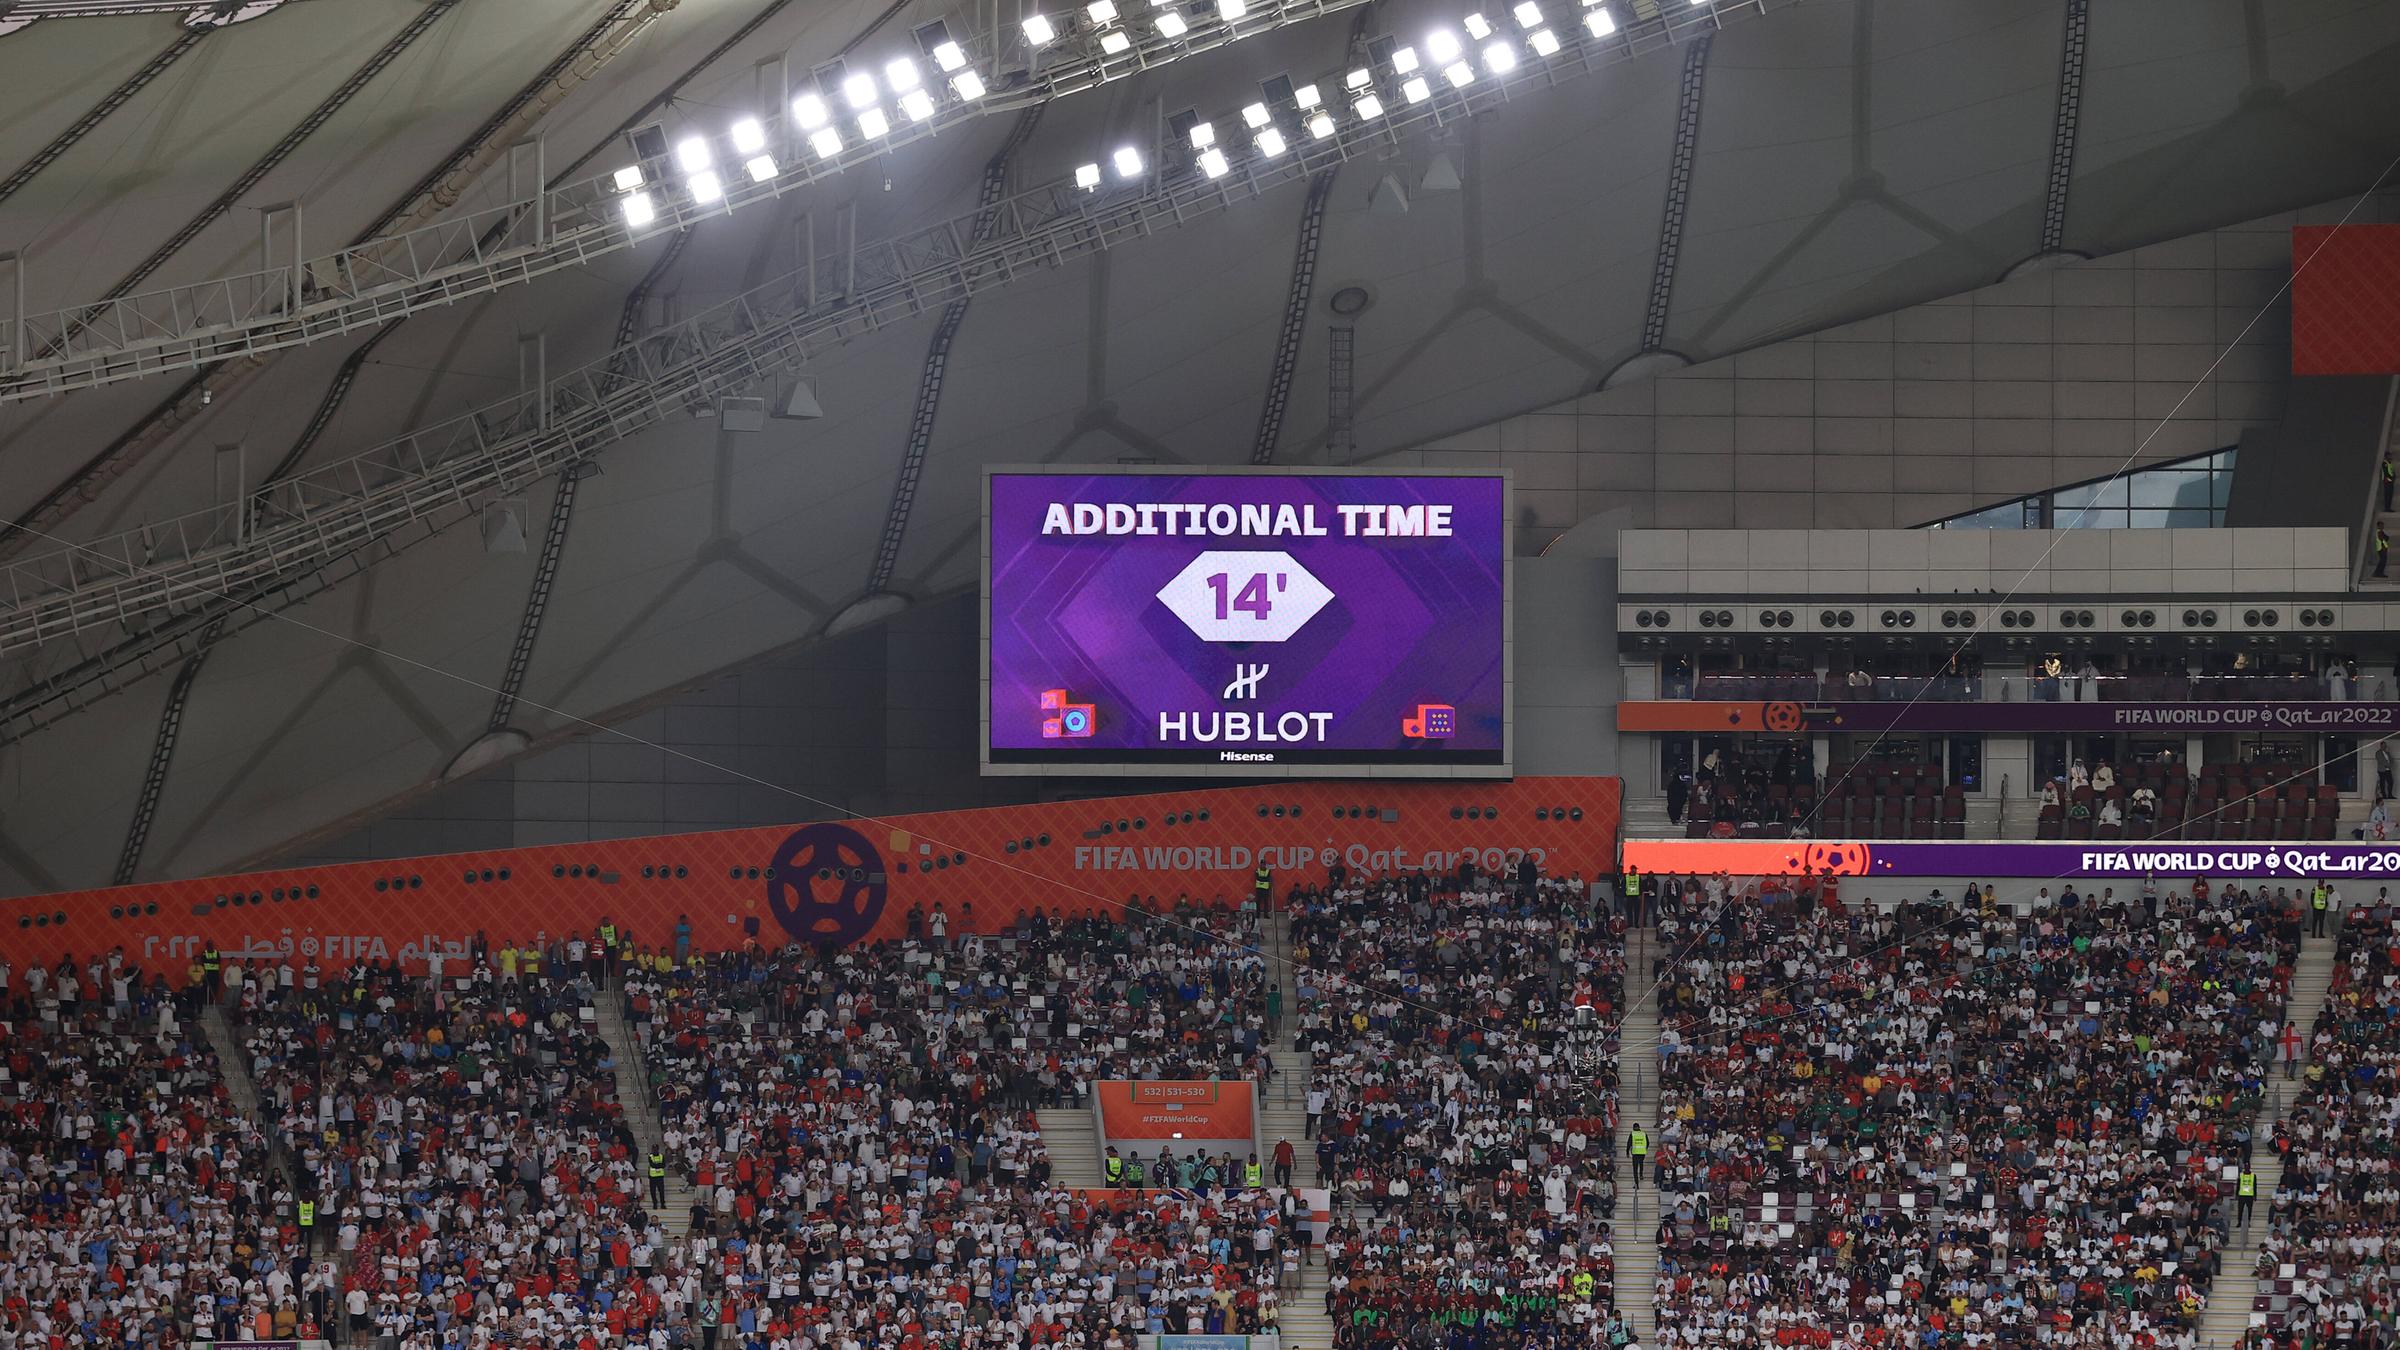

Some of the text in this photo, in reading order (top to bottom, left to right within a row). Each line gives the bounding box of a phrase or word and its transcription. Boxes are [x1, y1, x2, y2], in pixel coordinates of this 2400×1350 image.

[1041, 503, 1453, 537] ADDITIONAL TIME
[1207, 573, 1287, 620] 14'
[1159, 711, 1333, 742] HUBLOT
[2115, 709, 2156, 724] FIFA
[2155, 709, 2220, 724] WORLD
[2223, 709, 2258, 724] CUP
[1219, 752, 1275, 762] Hisense
[1074, 846, 1140, 870] FIFA
[1143, 846, 1251, 870] WORLD
[1257, 846, 1315, 870] CUP
[2082, 852, 2134, 871] FIFA
[2132, 852, 2214, 871] WORLD
[2217, 852, 2262, 871] CUP
[324, 936, 389, 960] FIFA
[1144, 1087, 1161, 1096] 532
[1143, 1115, 1209, 1125] #FIFAWorldCup
